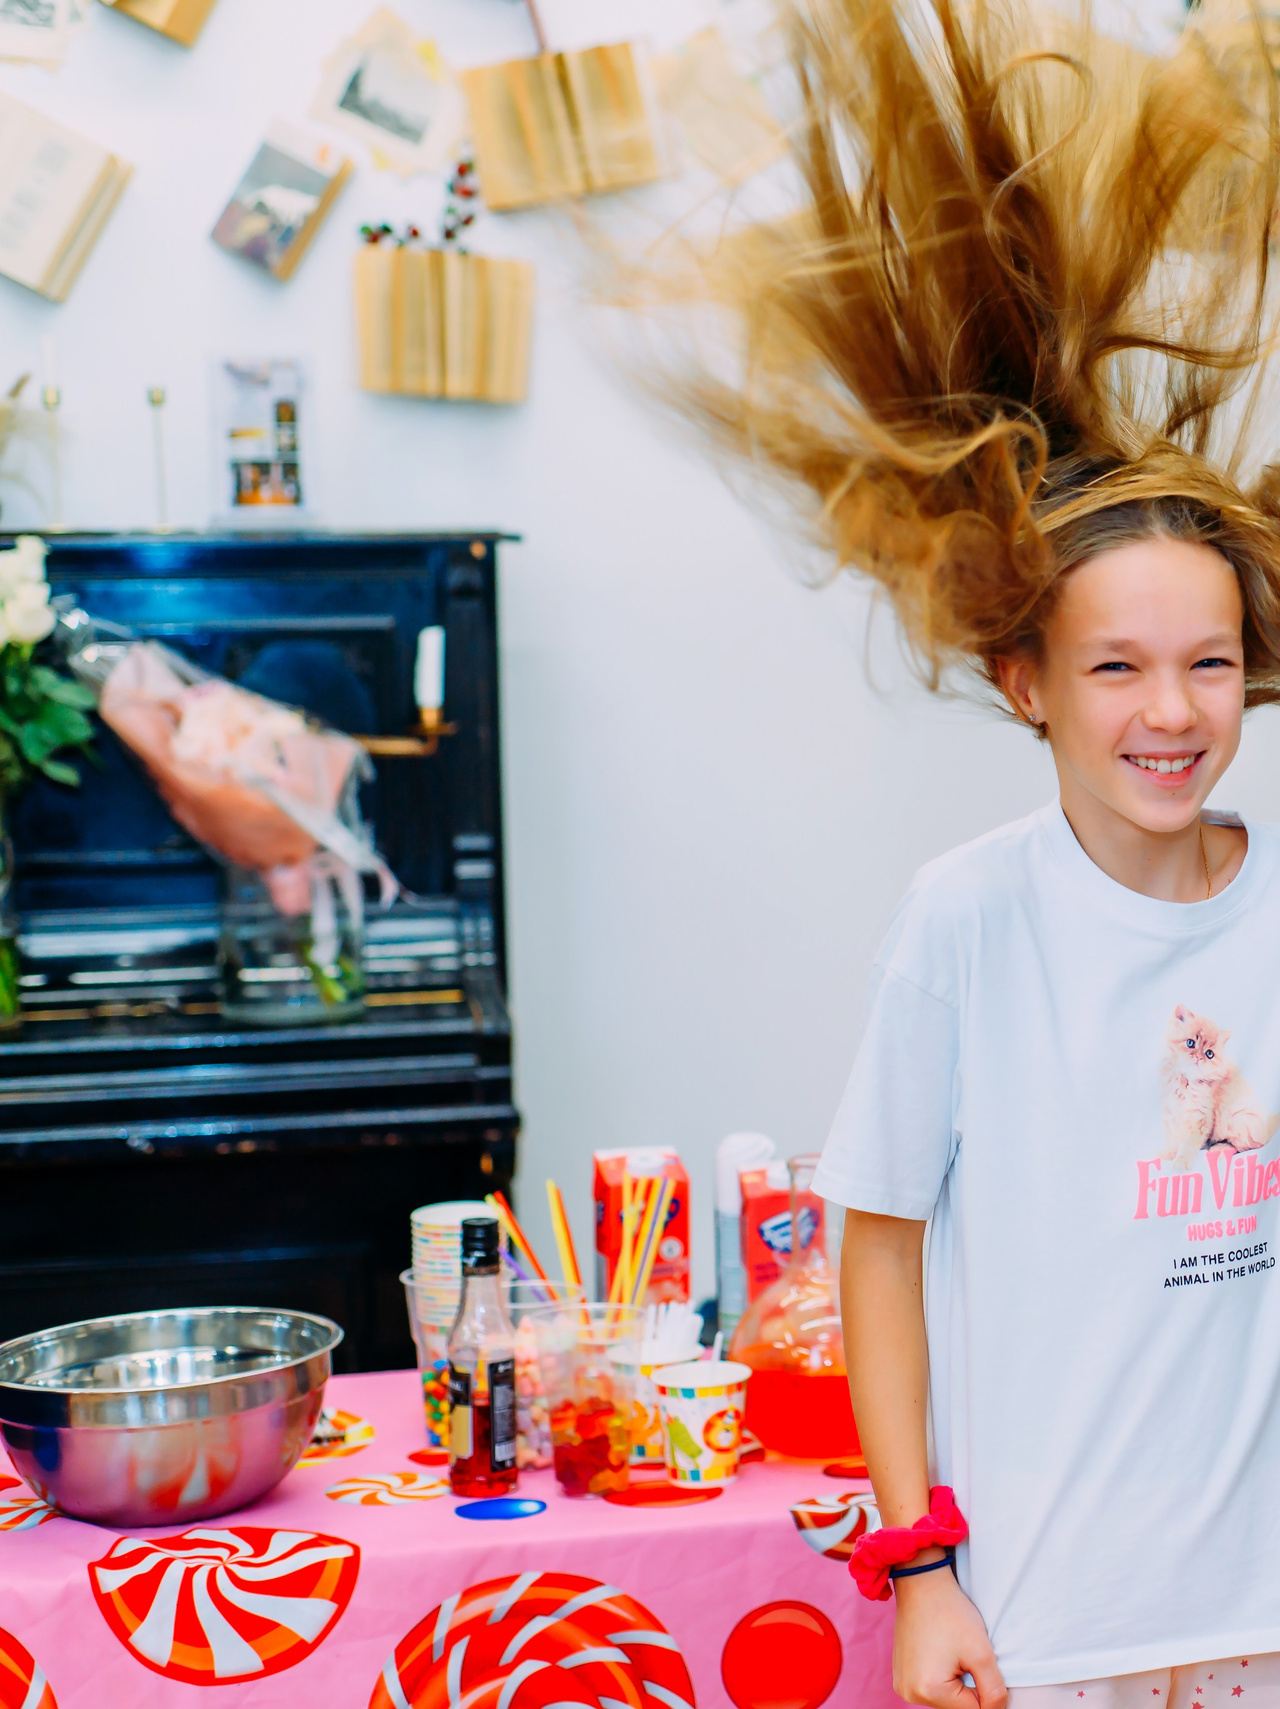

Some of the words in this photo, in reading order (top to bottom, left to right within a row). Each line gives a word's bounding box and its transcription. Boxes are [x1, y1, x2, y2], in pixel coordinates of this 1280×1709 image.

[1133, 1158, 1203, 1220] Fun
[1187, 1221, 1223, 1241] HUGS
[1226, 1219, 1236, 1236] &
[1237, 1215, 1257, 1235] FUN
[1173, 1259, 1177, 1269] I
[1180, 1256, 1198, 1269] AM
[1201, 1253, 1225, 1266] THE
[1228, 1242, 1268, 1262] COOLEST
[1163, 1273, 1209, 1288] ANIMAL
[1212, 1271, 1224, 1282] IN
[1227, 1266, 1246, 1279] THE
[1248, 1257, 1276, 1275] WORLD
